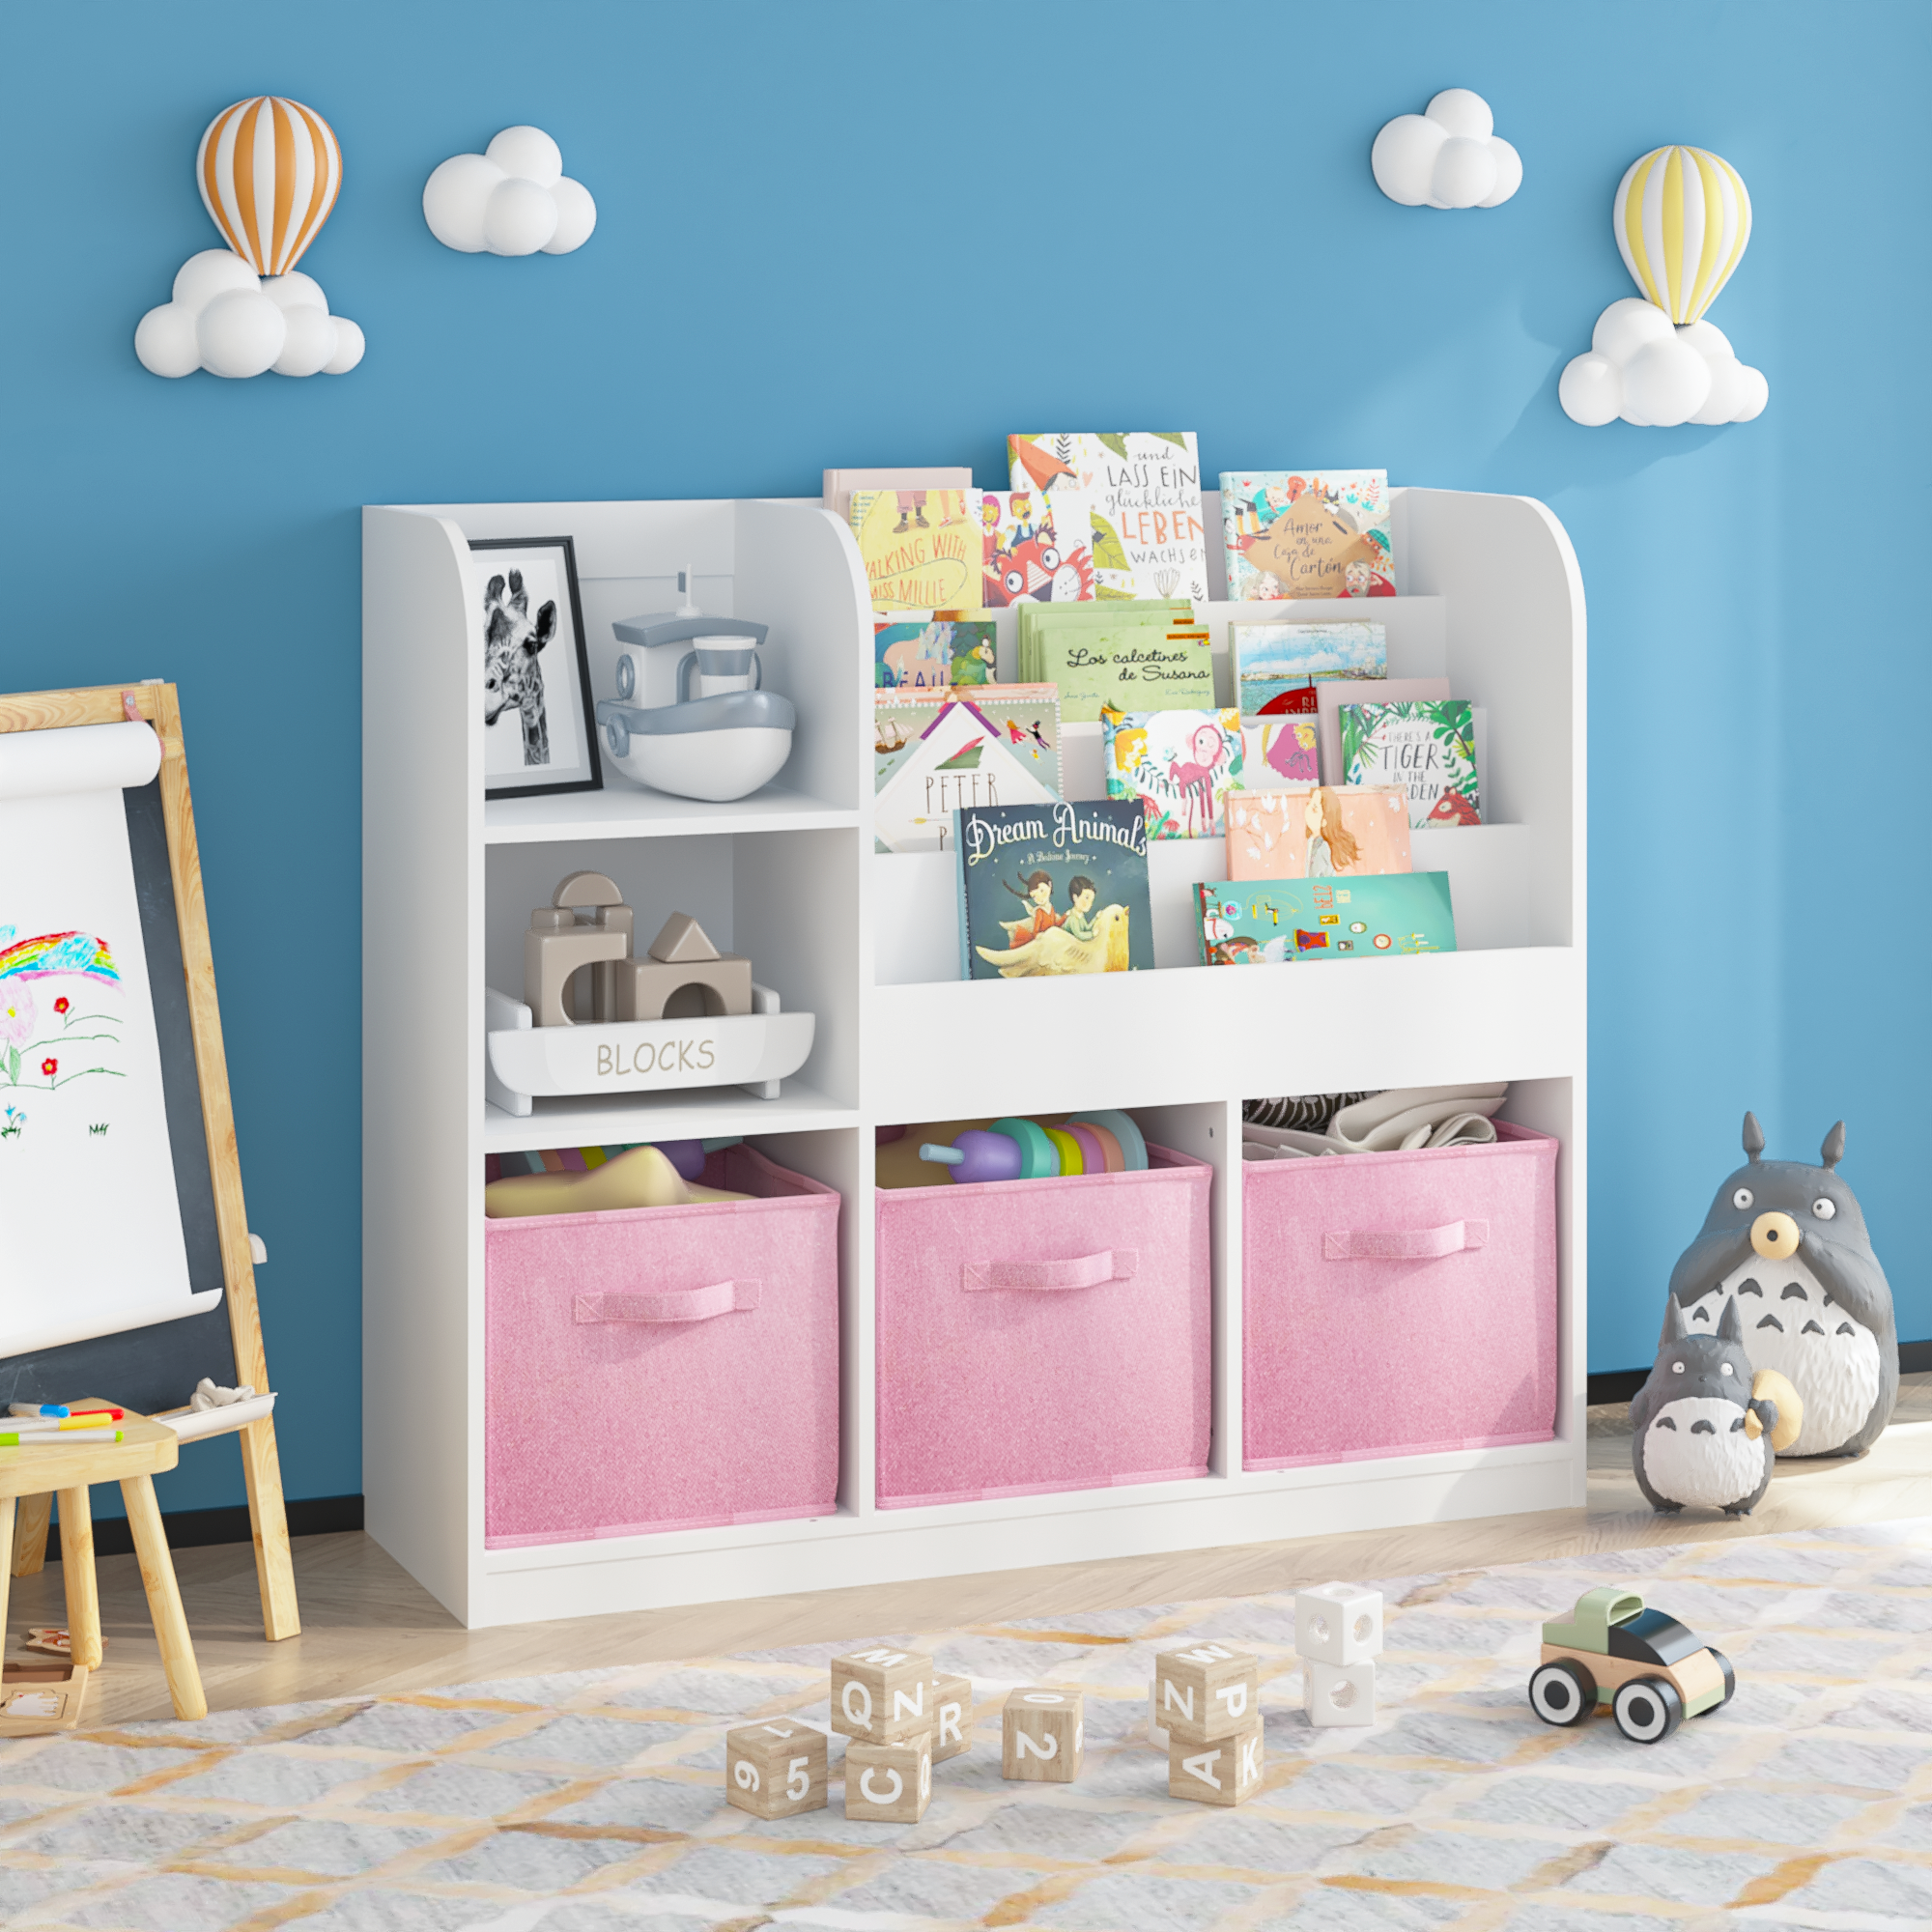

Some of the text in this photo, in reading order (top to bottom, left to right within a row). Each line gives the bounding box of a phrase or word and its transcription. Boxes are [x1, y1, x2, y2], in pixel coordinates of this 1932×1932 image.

[1133, 446, 1174, 461] und
[1107, 464, 1149, 488] LASS
[1283, 518, 1323, 536] Amor
[932, 533, 967, 560] WITH
[1290, 557, 1344, 581] Cartón
[898, 579, 946, 606] MILLIE
[1067, 648, 1188, 668] Los calcetines
[1119, 665, 1210, 681] de Susana
[1388, 731, 1431, 742] THERE'S A
[1379, 743, 1439, 770] TIGER
[1393, 771, 1426, 782] IN THE
[925, 773, 999, 813] PETER
[1408, 783, 1439, 800] DEN
[966, 801, 1148, 867] Dream Animals
[596, 1039, 715, 1076] BLOCKS
[841, 1680, 872, 1731] Q
[1215, 1682, 1247, 1718] P
[940, 1702, 963, 1747] R
[1016, 1730, 1058, 1761] 2
[1182, 1748, 1221, 1790] A
[1242, 1736, 1258, 1787] K
[786, 1756, 810, 1801] 5
[860, 1767, 903, 1804] C
